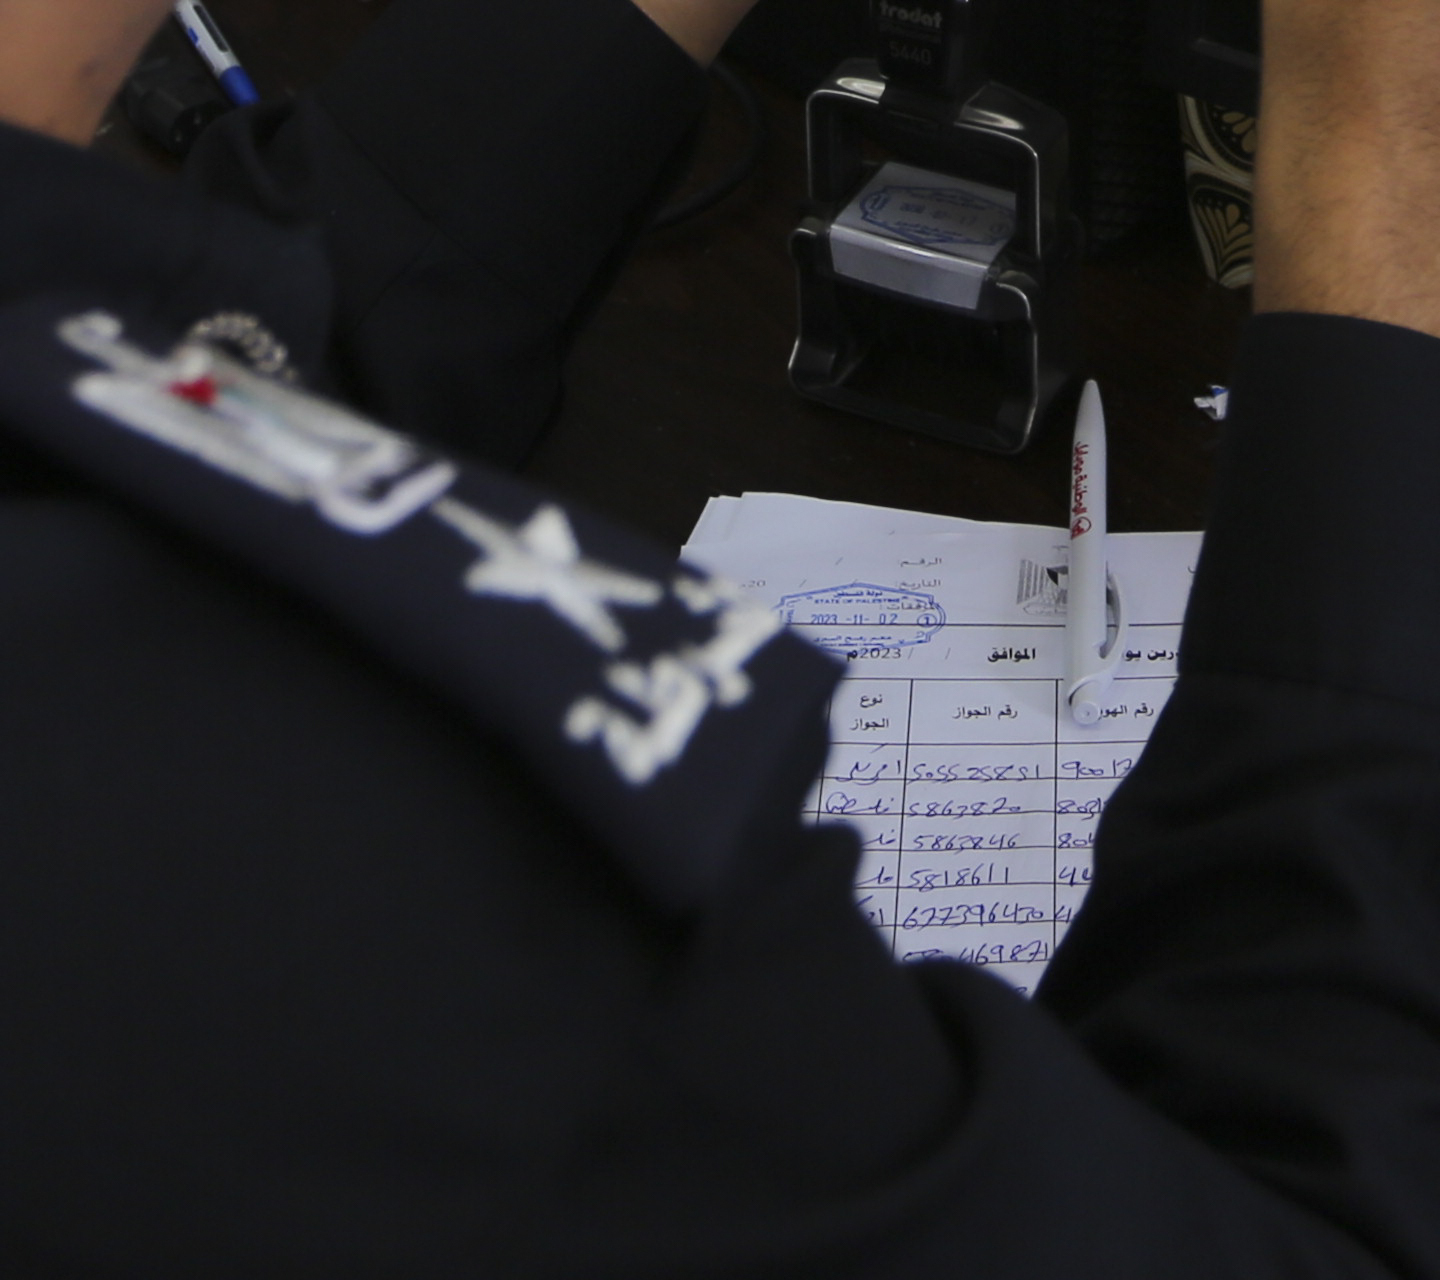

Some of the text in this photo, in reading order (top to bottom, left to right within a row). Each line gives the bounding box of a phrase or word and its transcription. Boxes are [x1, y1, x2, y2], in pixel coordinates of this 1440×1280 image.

[811, 613, 838, 625] 2023
[987, 647, 1036, 663] الموافق
[860, 693, 883, 708] نوع
[952, 704, 1018, 720] رقم الجواز
[1134, 704, 1154, 719] رقم
[850, 717, 890, 731] الجواز
